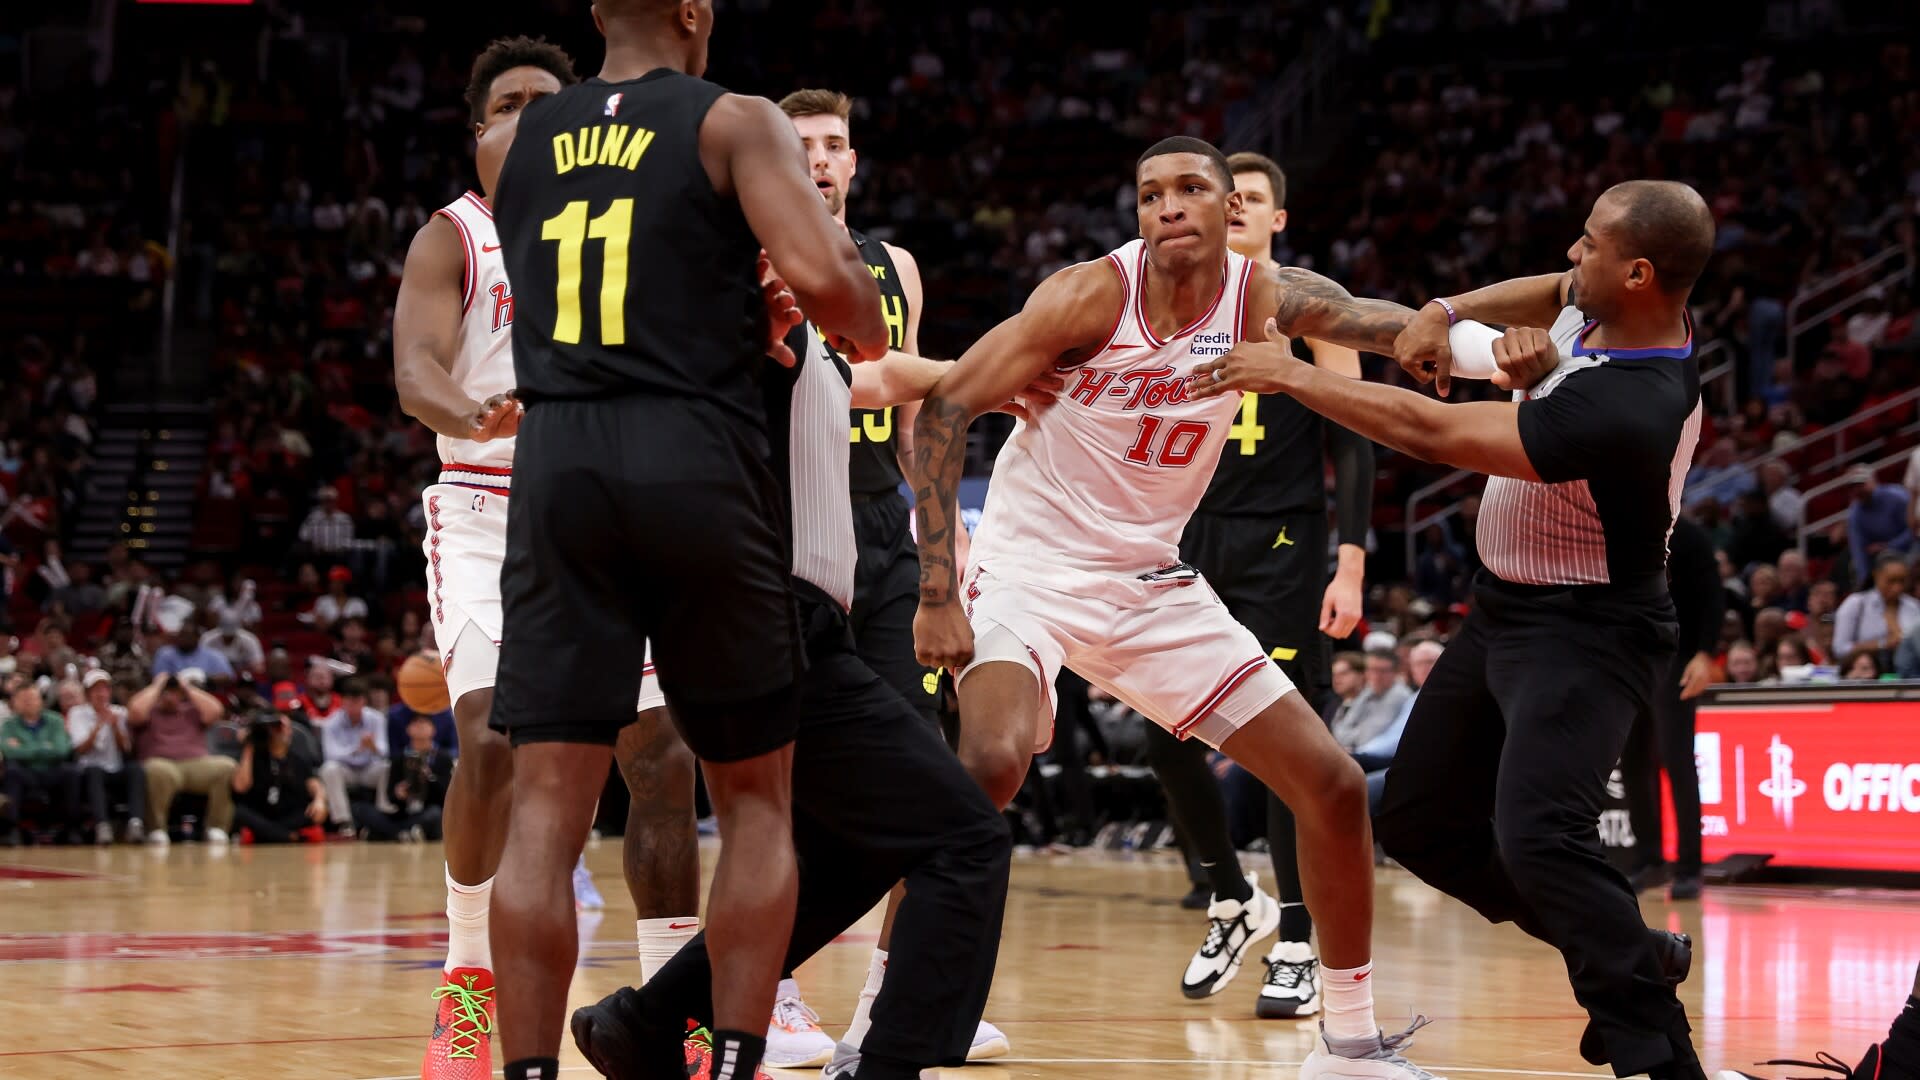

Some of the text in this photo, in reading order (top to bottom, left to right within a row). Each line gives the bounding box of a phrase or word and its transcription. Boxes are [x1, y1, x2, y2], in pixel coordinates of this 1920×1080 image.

[552, 124, 656, 175] DUNN
[541, 198, 635, 346] 11
[1190, 345, 1230, 356] karma
[1193, 332, 1231, 345] credit
[1123, 413, 1211, 468] 10
[1823, 762, 1920, 813] OFFIC
